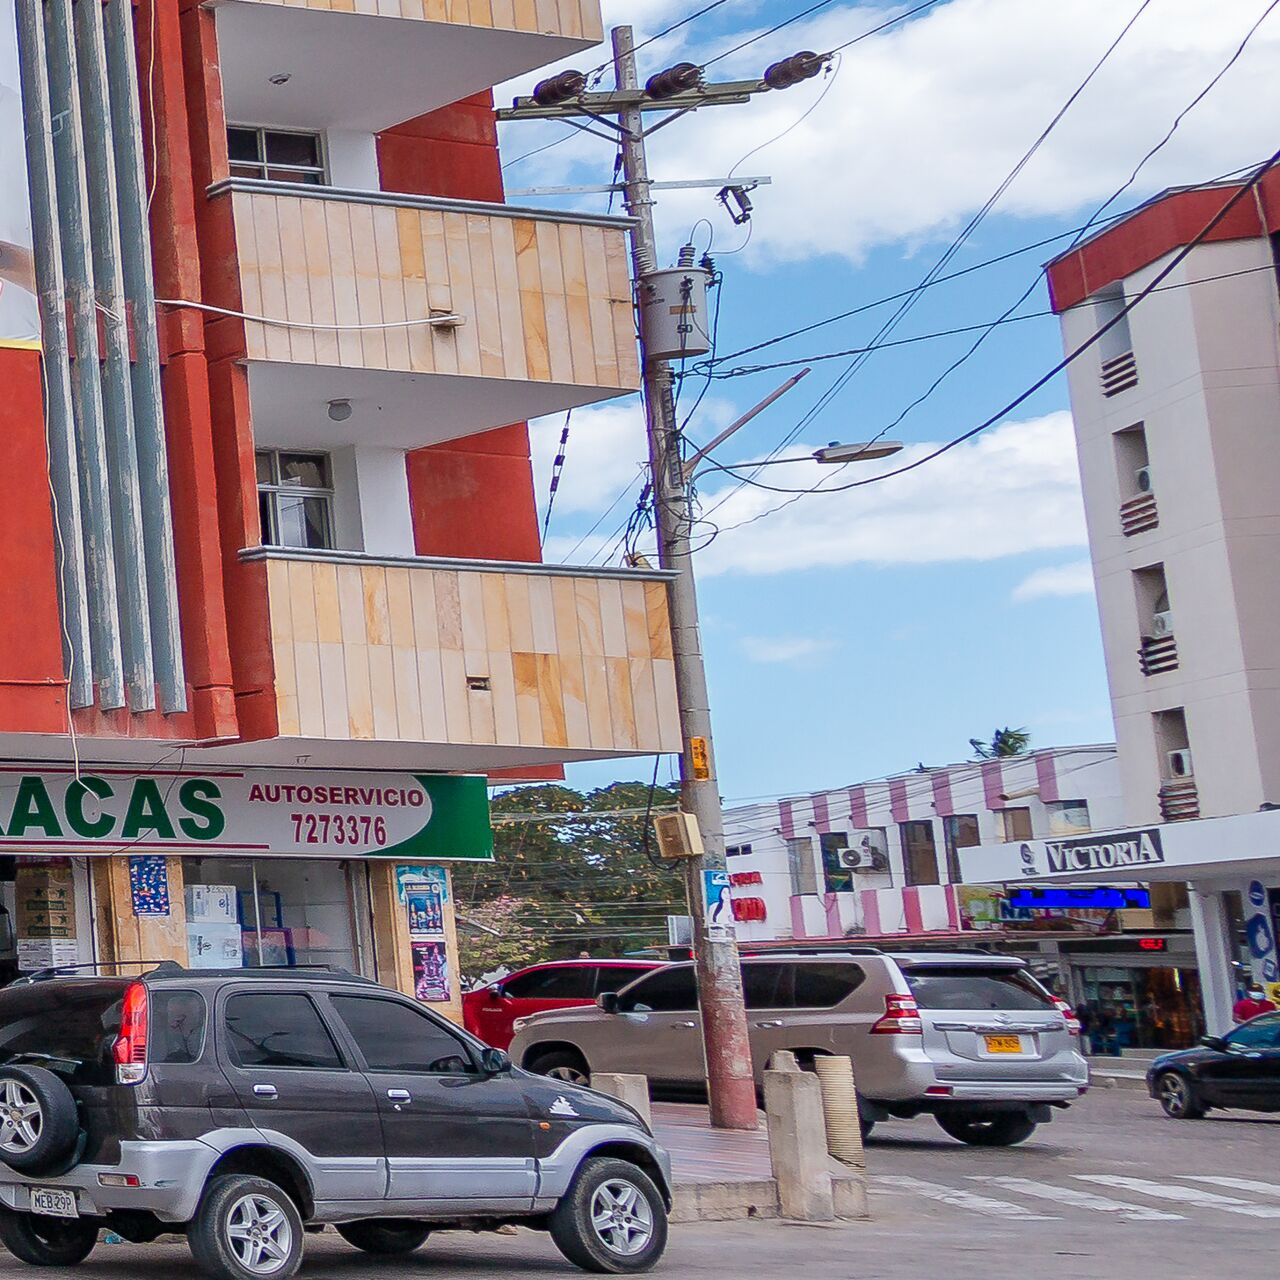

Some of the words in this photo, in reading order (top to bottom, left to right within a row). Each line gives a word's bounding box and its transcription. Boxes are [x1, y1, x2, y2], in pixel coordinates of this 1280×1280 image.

[247, 782, 425, 808] AUTOSERVICIO
[290, 813, 387, 847] 7273376
[1046, 833, 1161, 871] VICTORIA
